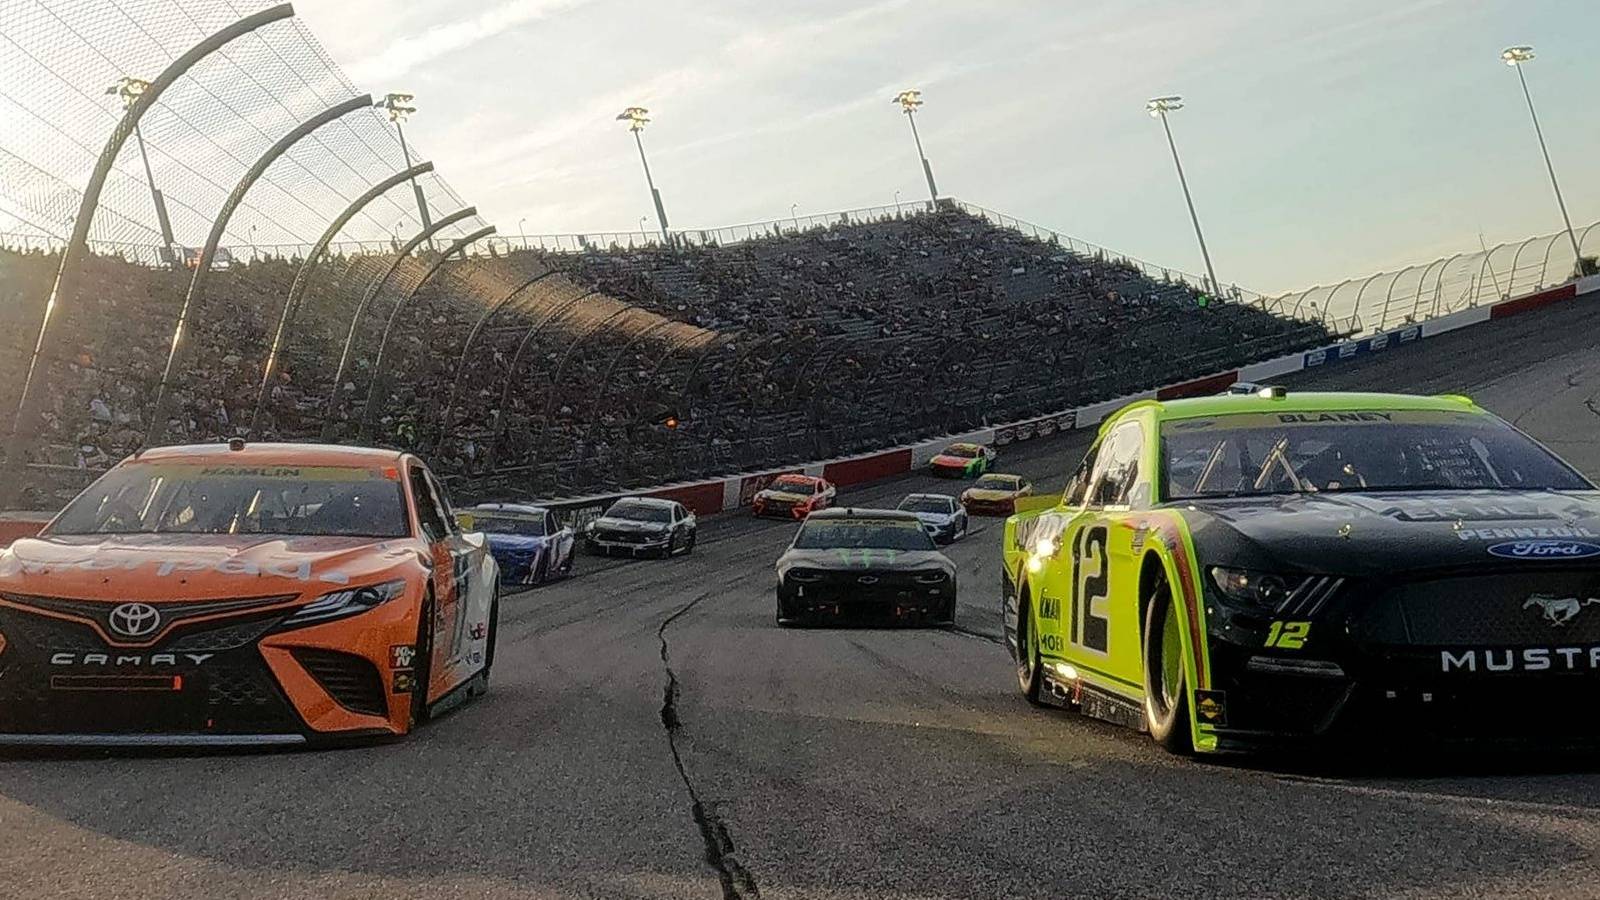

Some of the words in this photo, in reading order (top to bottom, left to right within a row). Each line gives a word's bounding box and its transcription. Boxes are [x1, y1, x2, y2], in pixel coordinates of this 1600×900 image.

[1277, 412, 1393, 424] BLANEY
[201, 467, 300, 477] HAMLIN
[1457, 526, 1600, 541] PENNZOIL
[1512, 541, 1583, 556] Ford
[1071, 525, 1109, 654] 12
[1264, 621, 1312, 648] 12
